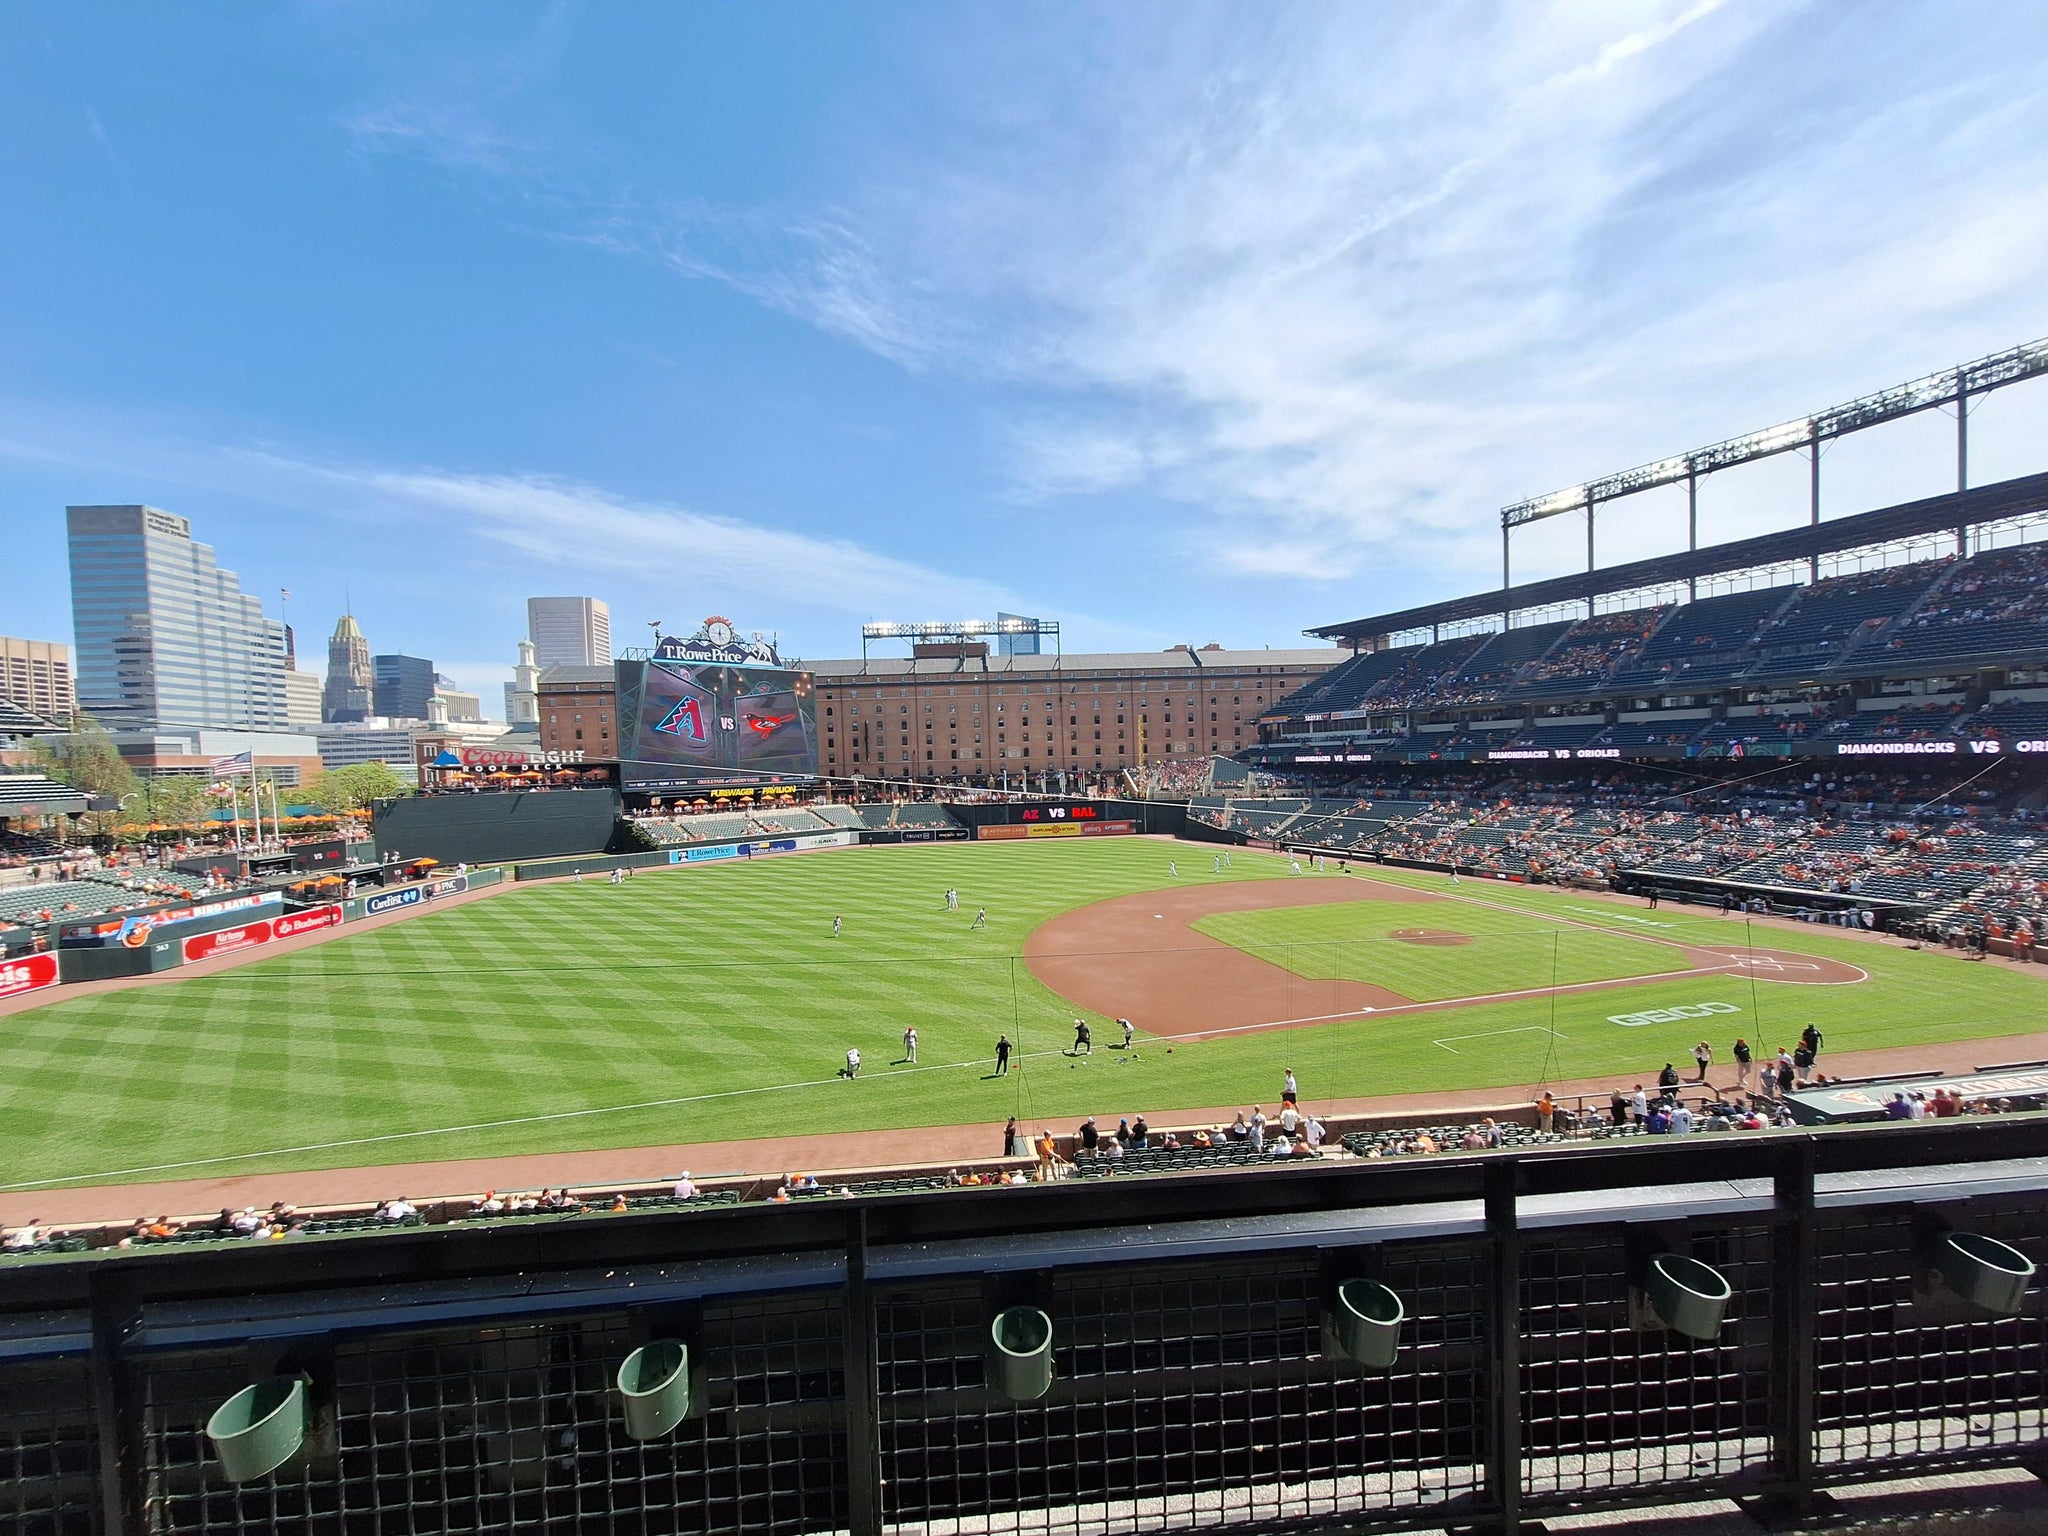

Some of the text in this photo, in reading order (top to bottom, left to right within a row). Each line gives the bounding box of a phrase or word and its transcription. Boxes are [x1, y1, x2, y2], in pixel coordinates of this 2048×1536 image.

[720, 717, 735, 730] VS
[1838, 741, 1956, 755] DIAMONDBACKS
[1970, 740, 2000, 754] VS
[462, 745, 586, 765] Coors LIGHT
[1295, 754, 1372, 763] DIAMONDBACKS VS ORIOLES
[1488, 749, 1621, 760] DIAMONDBACKS VS ORIOLES
[462, 763, 563, 773] ROOF DECK
[711, 785, 797, 798] PUREWAGER PAVILION
[1022, 806, 1097, 820] AZ VS BAL
[442, 880, 457, 891] PNC
[371, 891, 404, 911] CareFirst
[193, 902, 223, 917] BIRD
[223, 899, 255, 911] BATH
[155, 943, 170, 953] 363
[1606, 1001, 1742, 1027] GEICO
